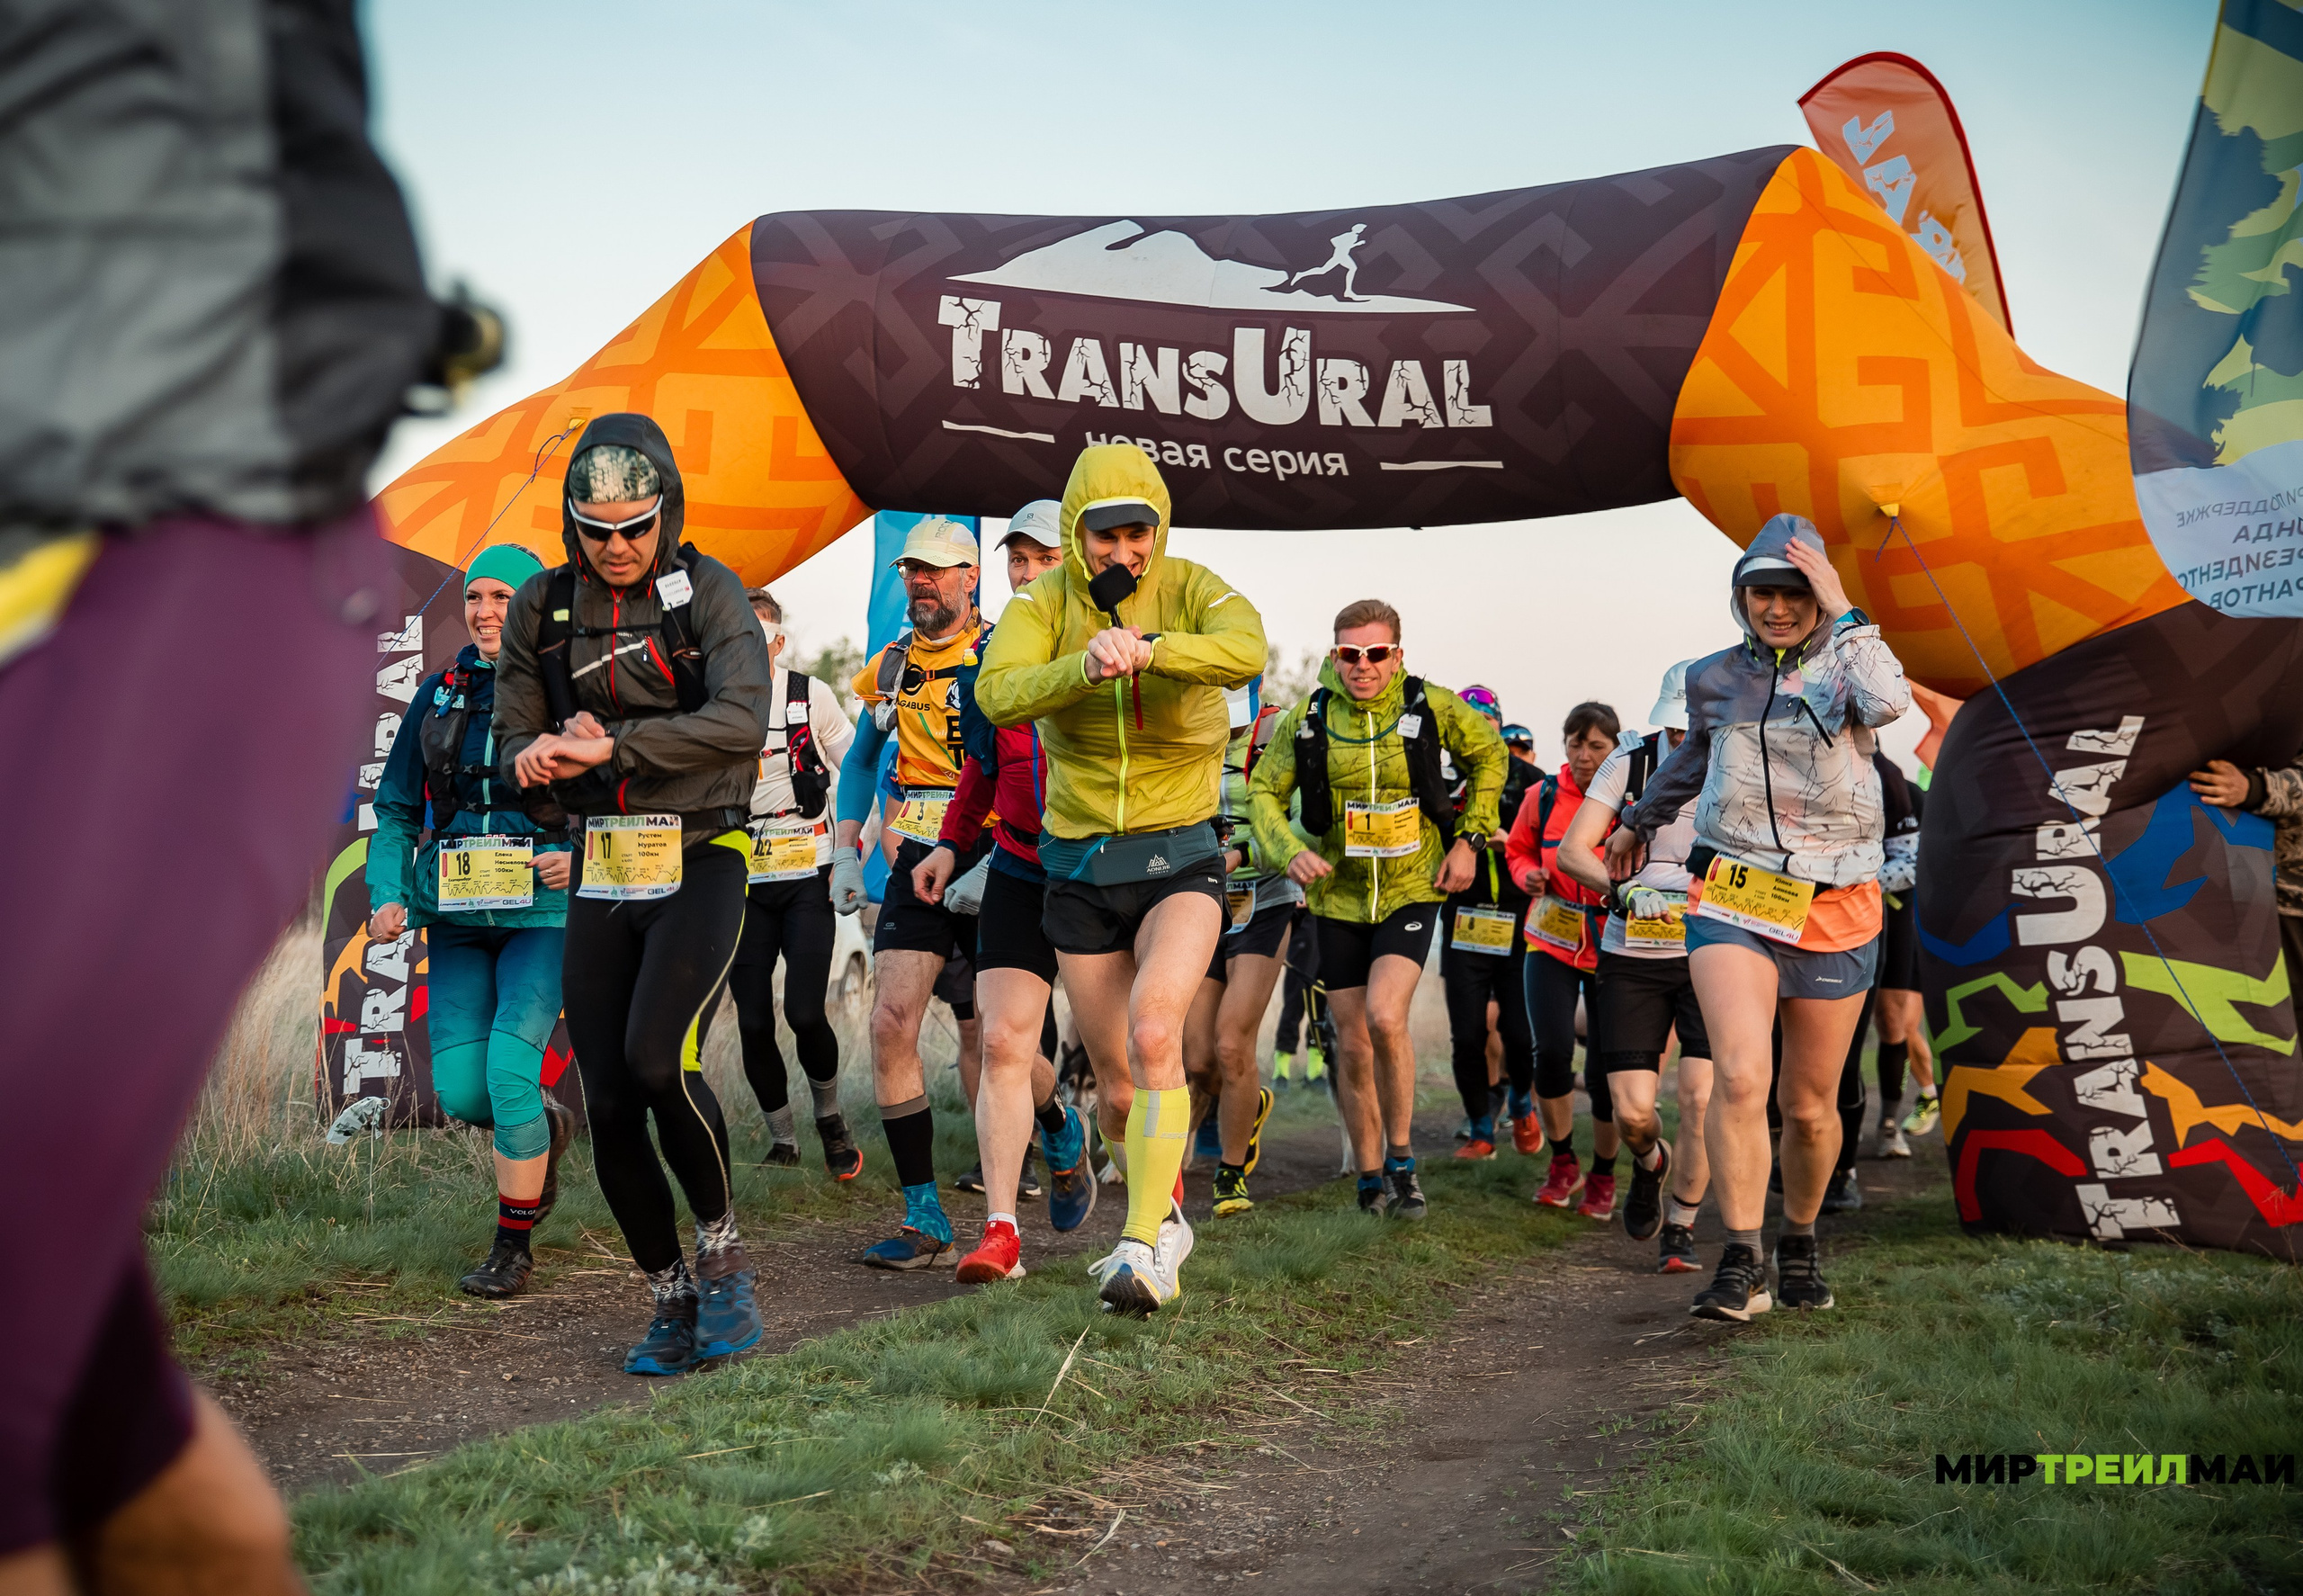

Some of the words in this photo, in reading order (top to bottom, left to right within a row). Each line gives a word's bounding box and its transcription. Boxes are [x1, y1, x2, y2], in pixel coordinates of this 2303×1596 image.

[1223, 444, 1349, 480] серия
[1366, 812, 1370, 830] 1
[601, 832, 611, 859] 17
[456, 852, 470, 875] 18
[1728, 864, 1749, 889] 15
